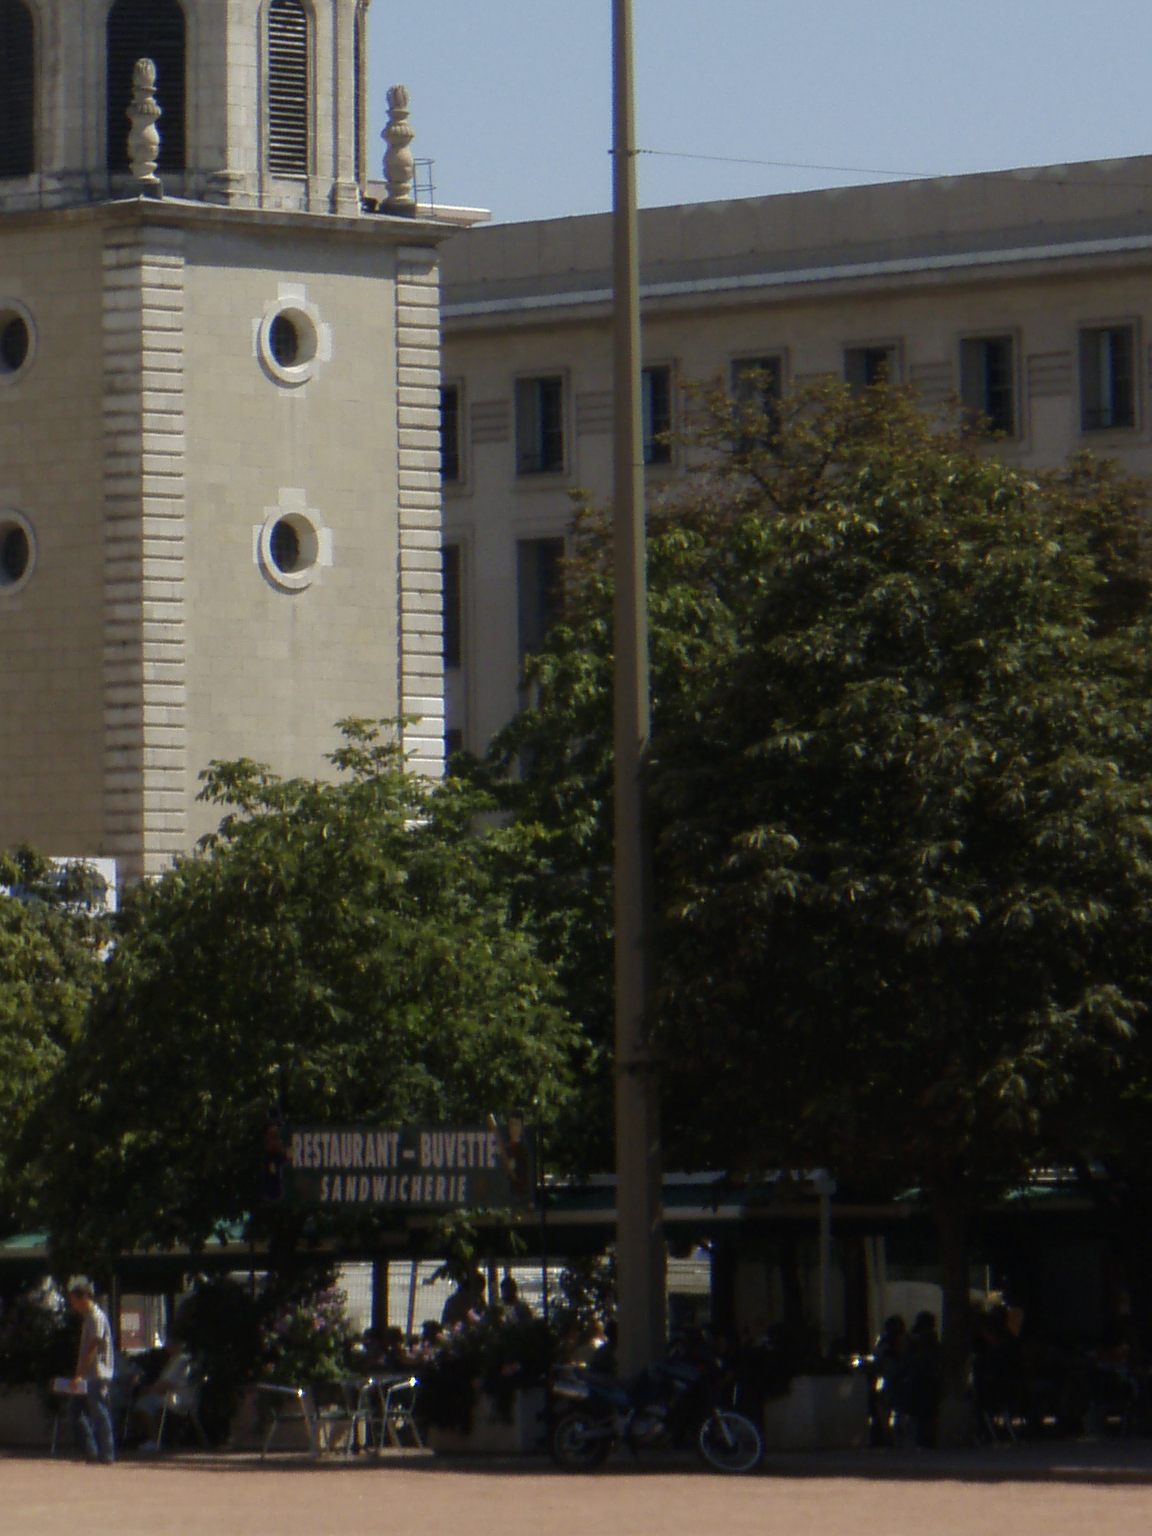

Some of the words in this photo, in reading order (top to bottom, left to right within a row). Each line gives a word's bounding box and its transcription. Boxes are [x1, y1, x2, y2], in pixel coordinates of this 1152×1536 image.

[291, 1132, 399, 1168] RESTAURANT
[420, 1132, 497, 1168] BUVETTE
[320, 1175, 467, 1201] SANDWICHERIE
